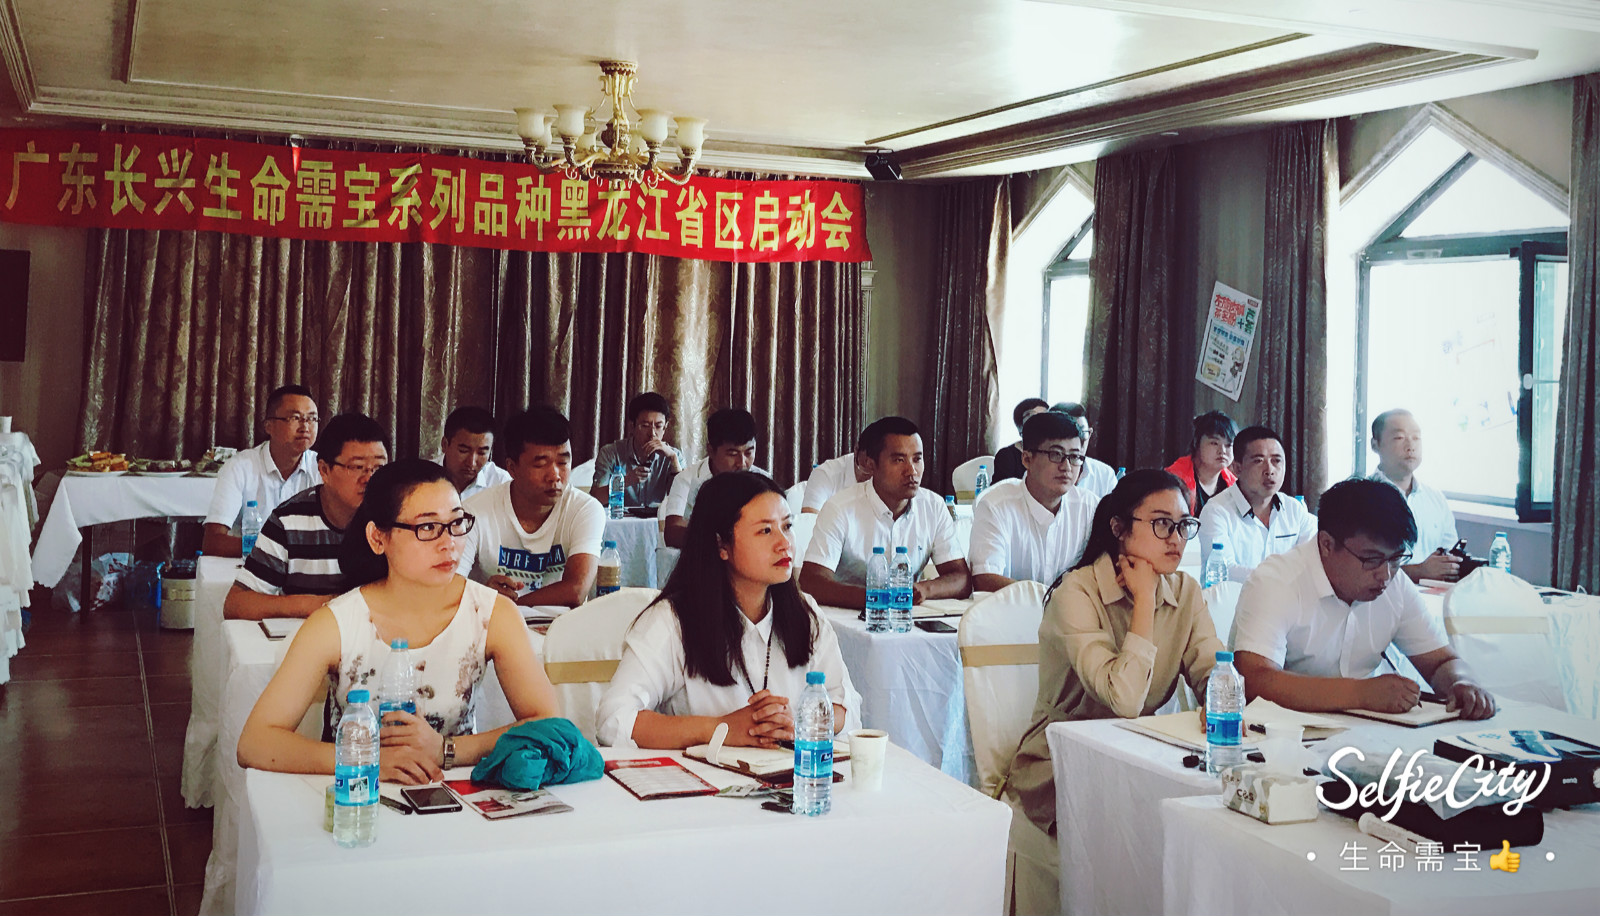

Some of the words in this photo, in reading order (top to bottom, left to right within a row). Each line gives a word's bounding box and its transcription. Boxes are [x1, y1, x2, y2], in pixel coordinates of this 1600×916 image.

[6, 140, 853, 252] 广东长兴生命需宝系列品种黑龙江省区启动会
